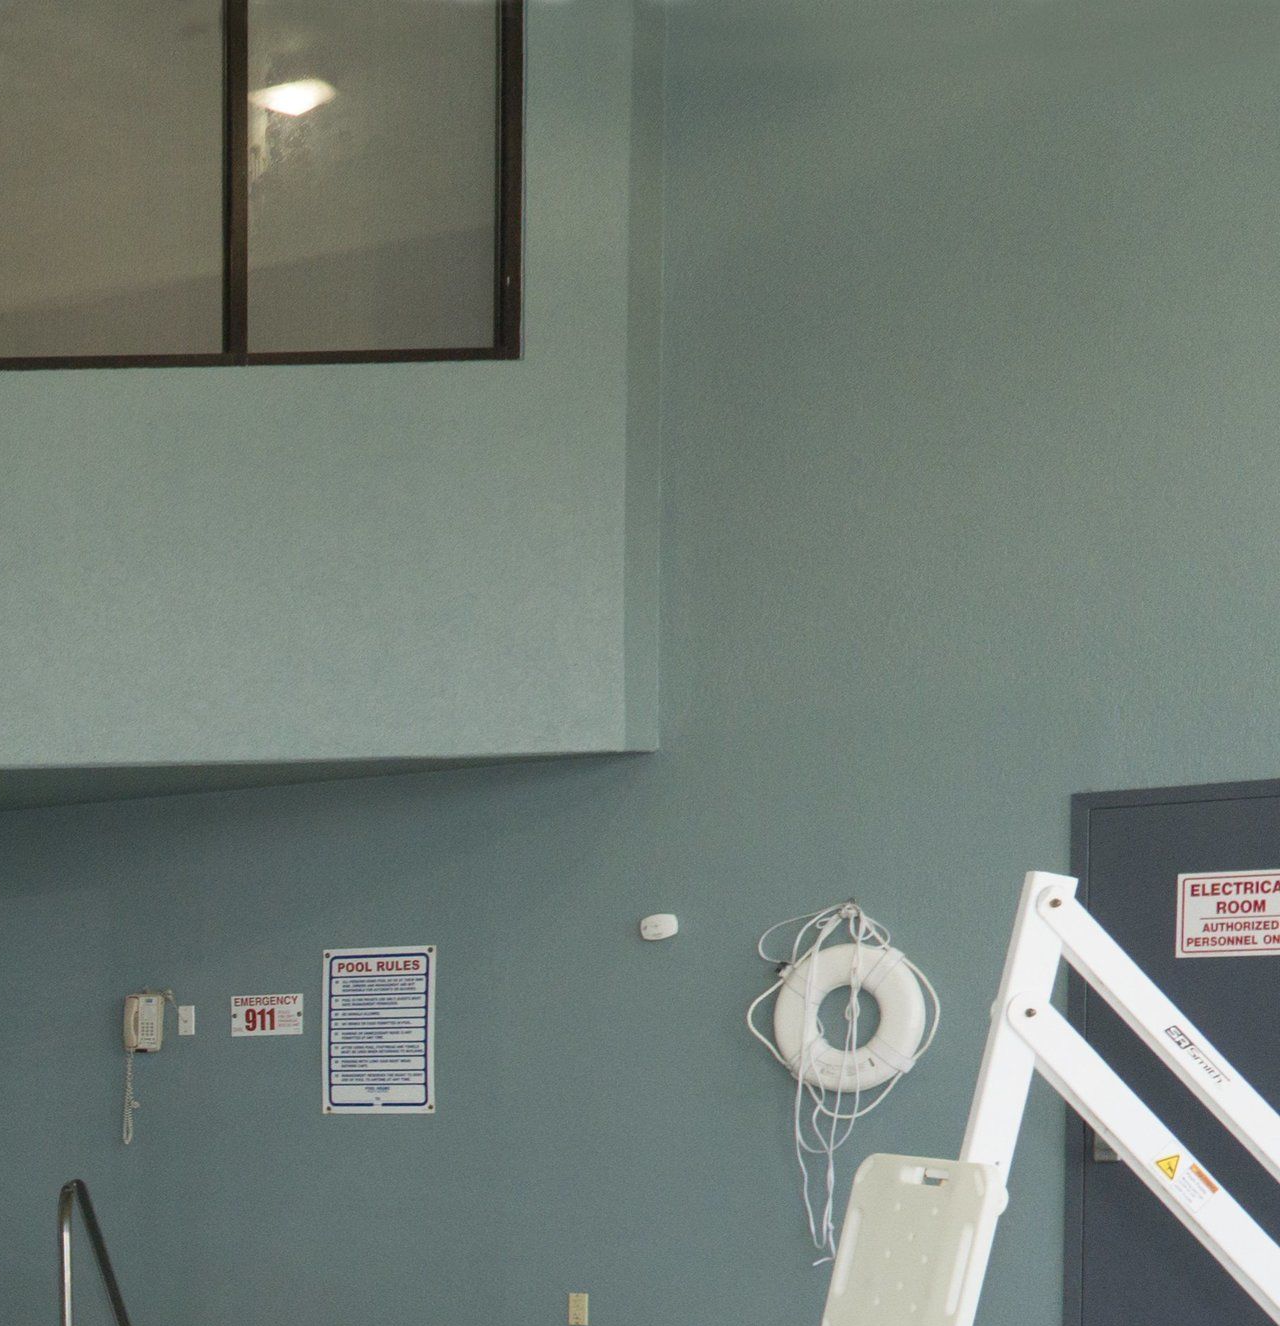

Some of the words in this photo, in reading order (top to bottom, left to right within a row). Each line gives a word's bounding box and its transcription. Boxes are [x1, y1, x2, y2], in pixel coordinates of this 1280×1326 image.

[1216, 899, 1266, 914] ROOM
[1202, 920, 1279, 933] AUTHORIZED
[1186, 936, 1258, 947] PERSONNEL
[337, 962, 372, 973] POOL
[376, 960, 420, 971] RULES
[234, 996, 298, 1006] EMERGENCY
[245, 1008, 275, 1031] 911
